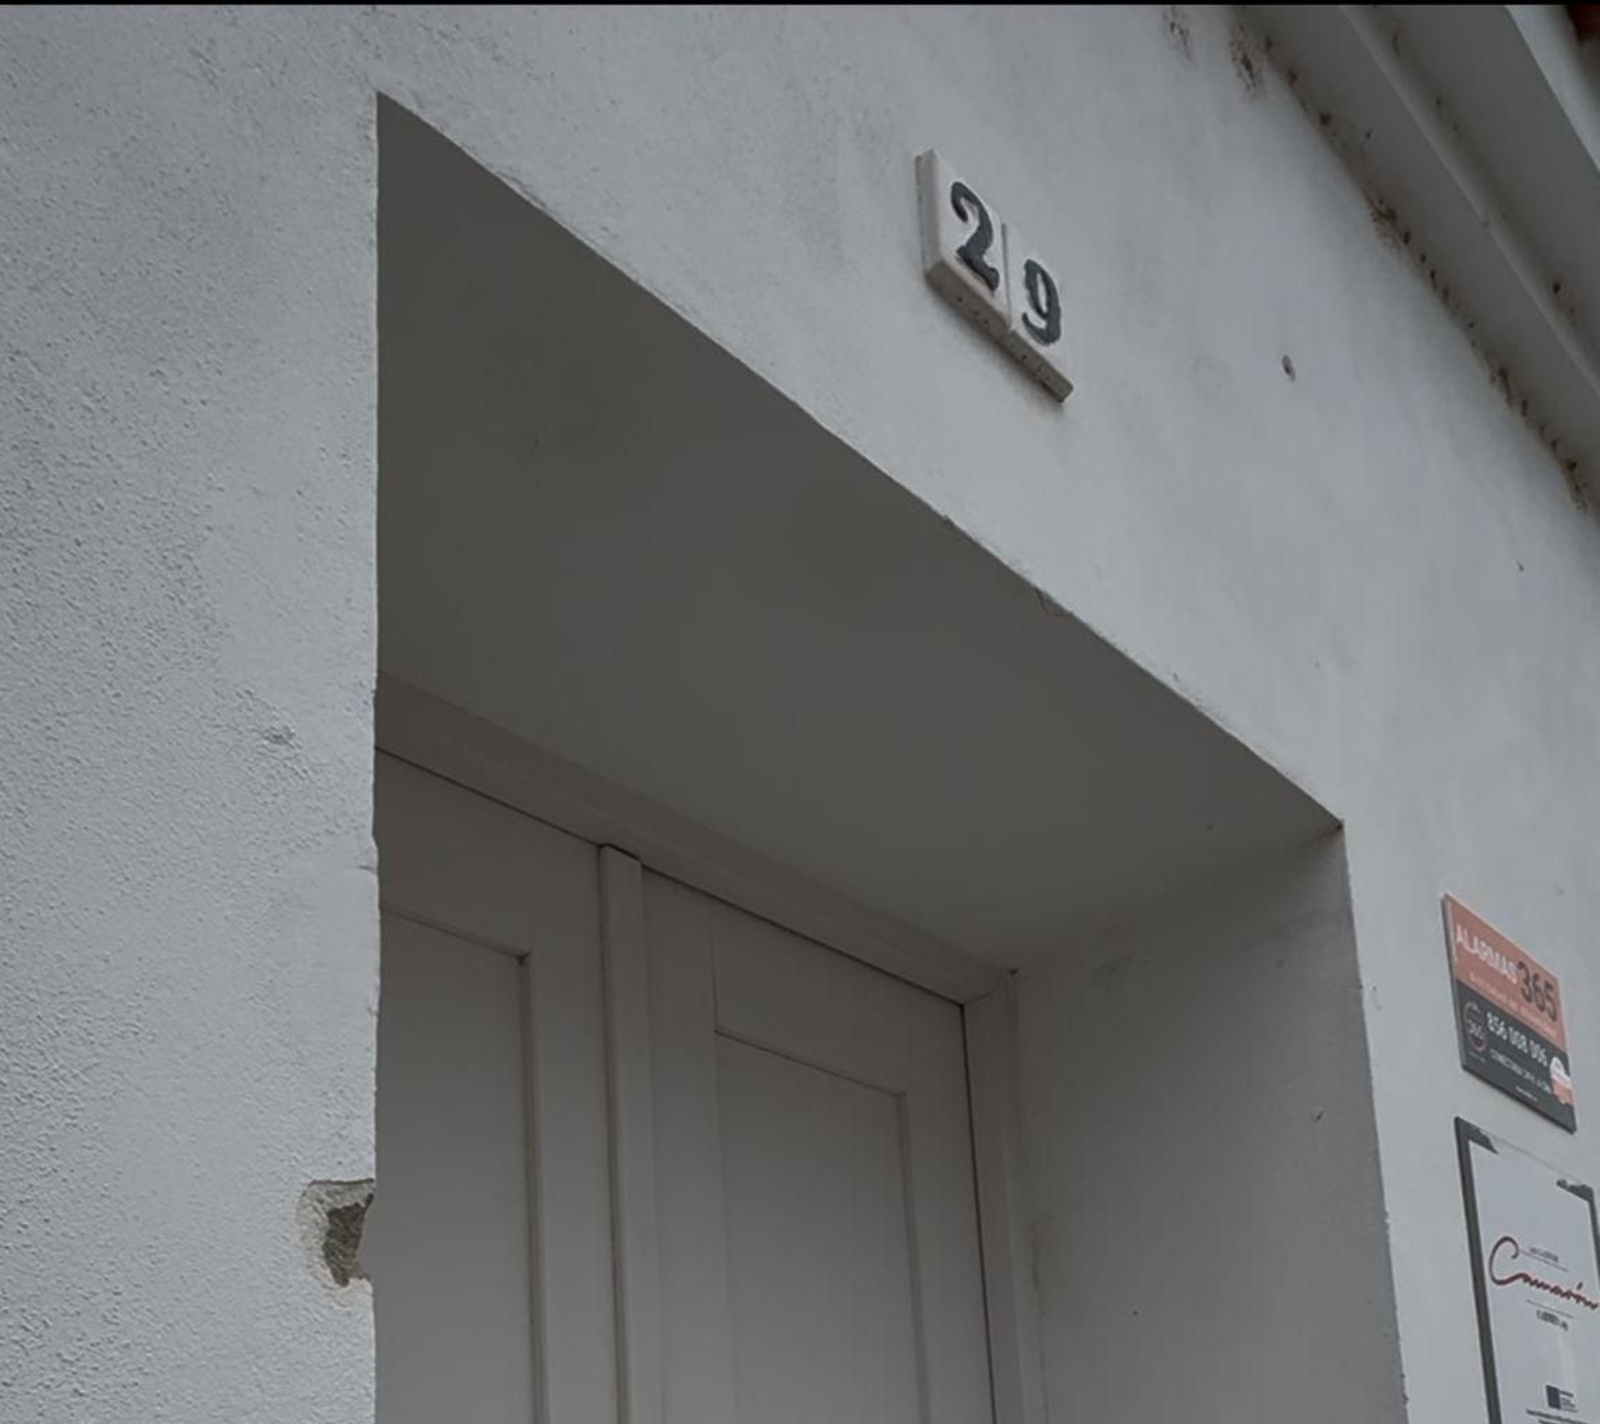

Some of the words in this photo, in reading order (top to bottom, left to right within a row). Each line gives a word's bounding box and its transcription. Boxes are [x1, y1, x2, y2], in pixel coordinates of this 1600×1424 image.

[951, 181, 1062, 346] 29
[1456, 923, 1517, 984] ALARMAS
[1517, 960, 1558, 1022] 365
